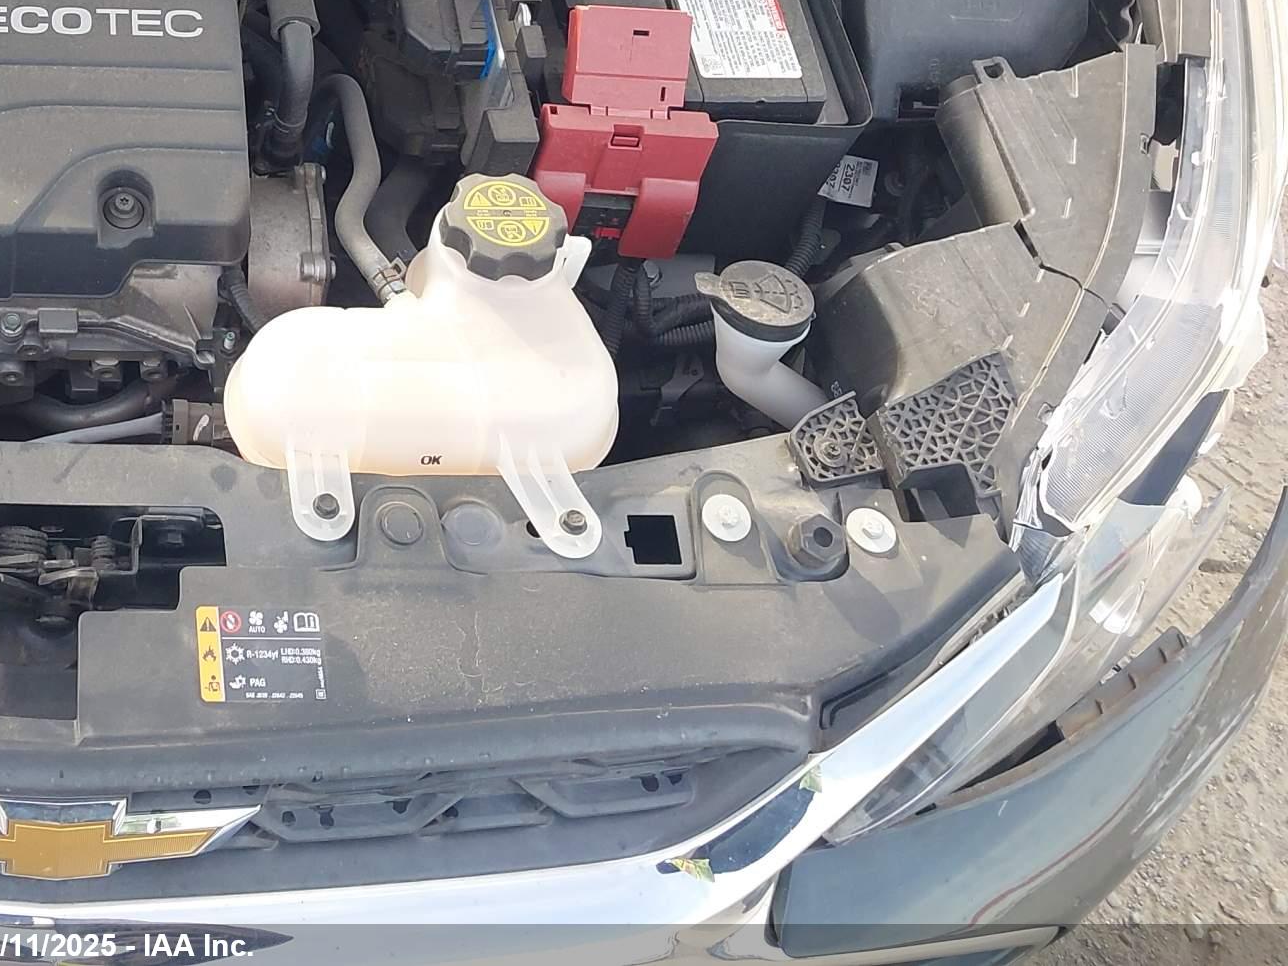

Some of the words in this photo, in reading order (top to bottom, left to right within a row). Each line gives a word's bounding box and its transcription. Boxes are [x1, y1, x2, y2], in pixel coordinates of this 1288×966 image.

[841, 163, 856, 192] 2307
[420, 455, 442, 465] OK
[248, 625, 266, 634] AUTO
[246, 649, 279, 661] R-1234yf
[249, 678, 266, 687] PAG
